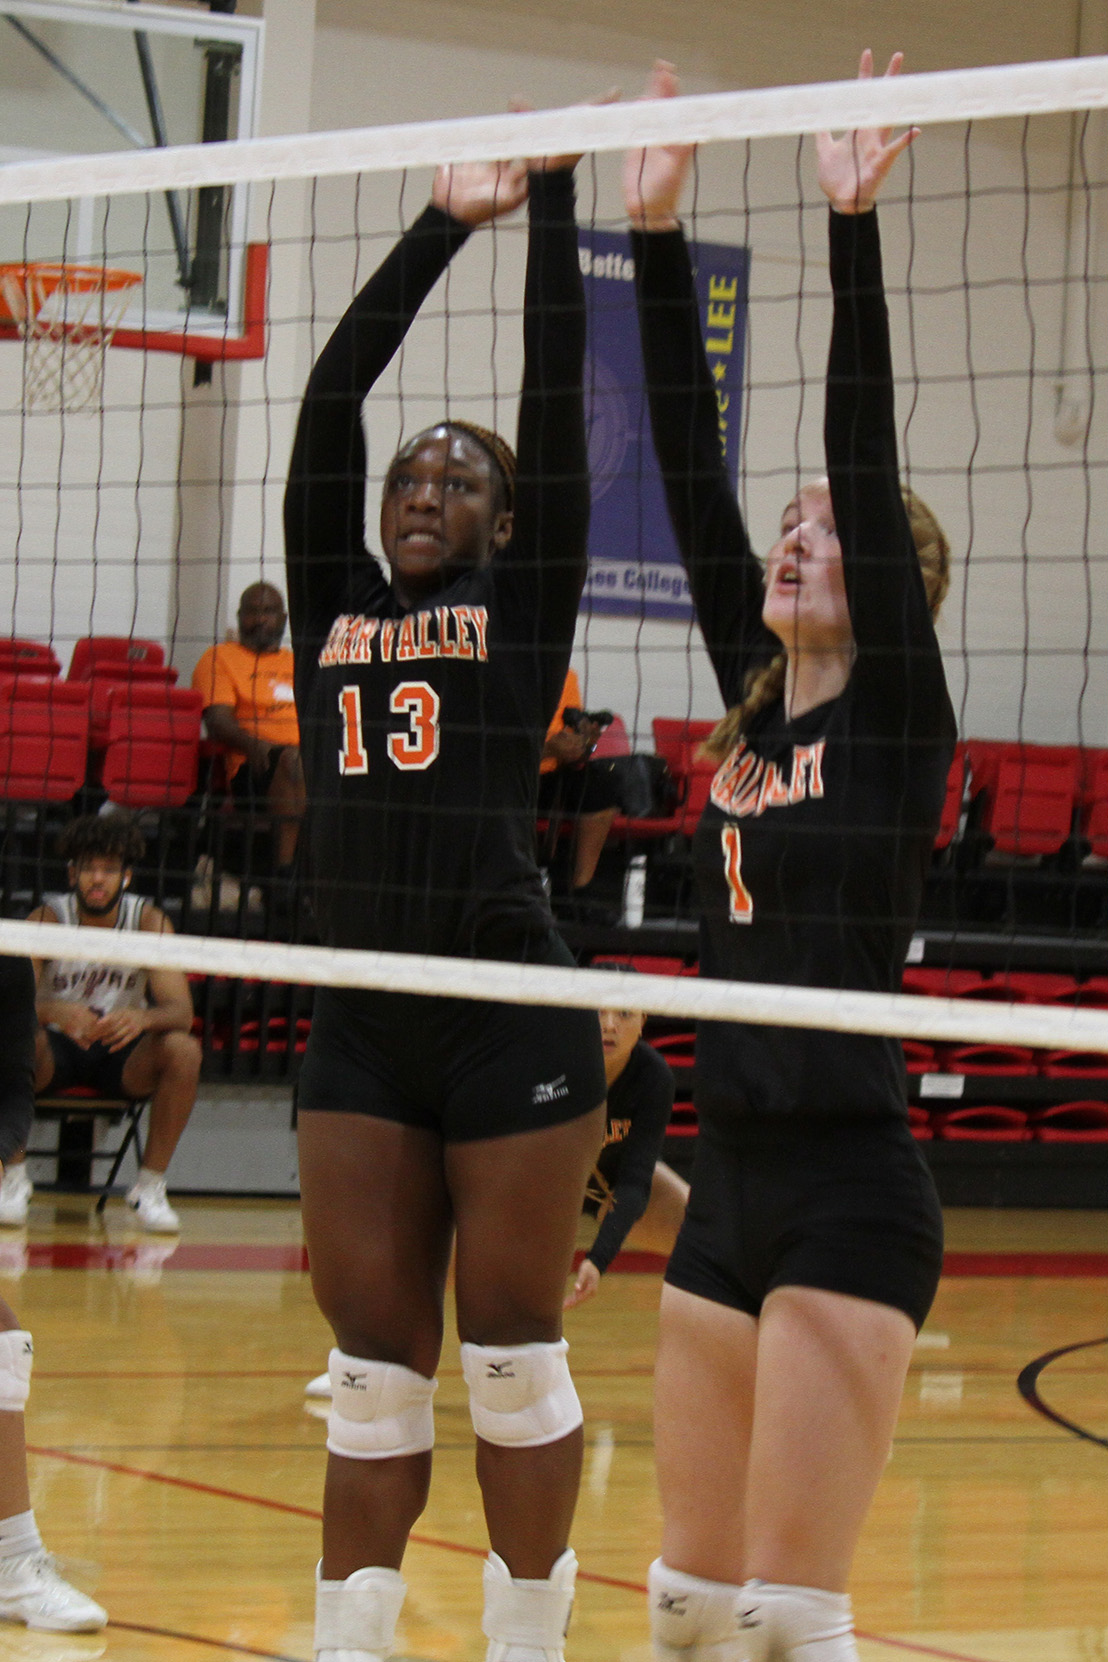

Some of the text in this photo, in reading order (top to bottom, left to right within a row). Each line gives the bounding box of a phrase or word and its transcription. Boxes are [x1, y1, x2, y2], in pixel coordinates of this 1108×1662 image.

[705, 274, 738, 355] LEE
[380, 605, 489, 663] VALLEY
[338, 681, 441, 775] 13
[721, 822, 753, 925] 1
